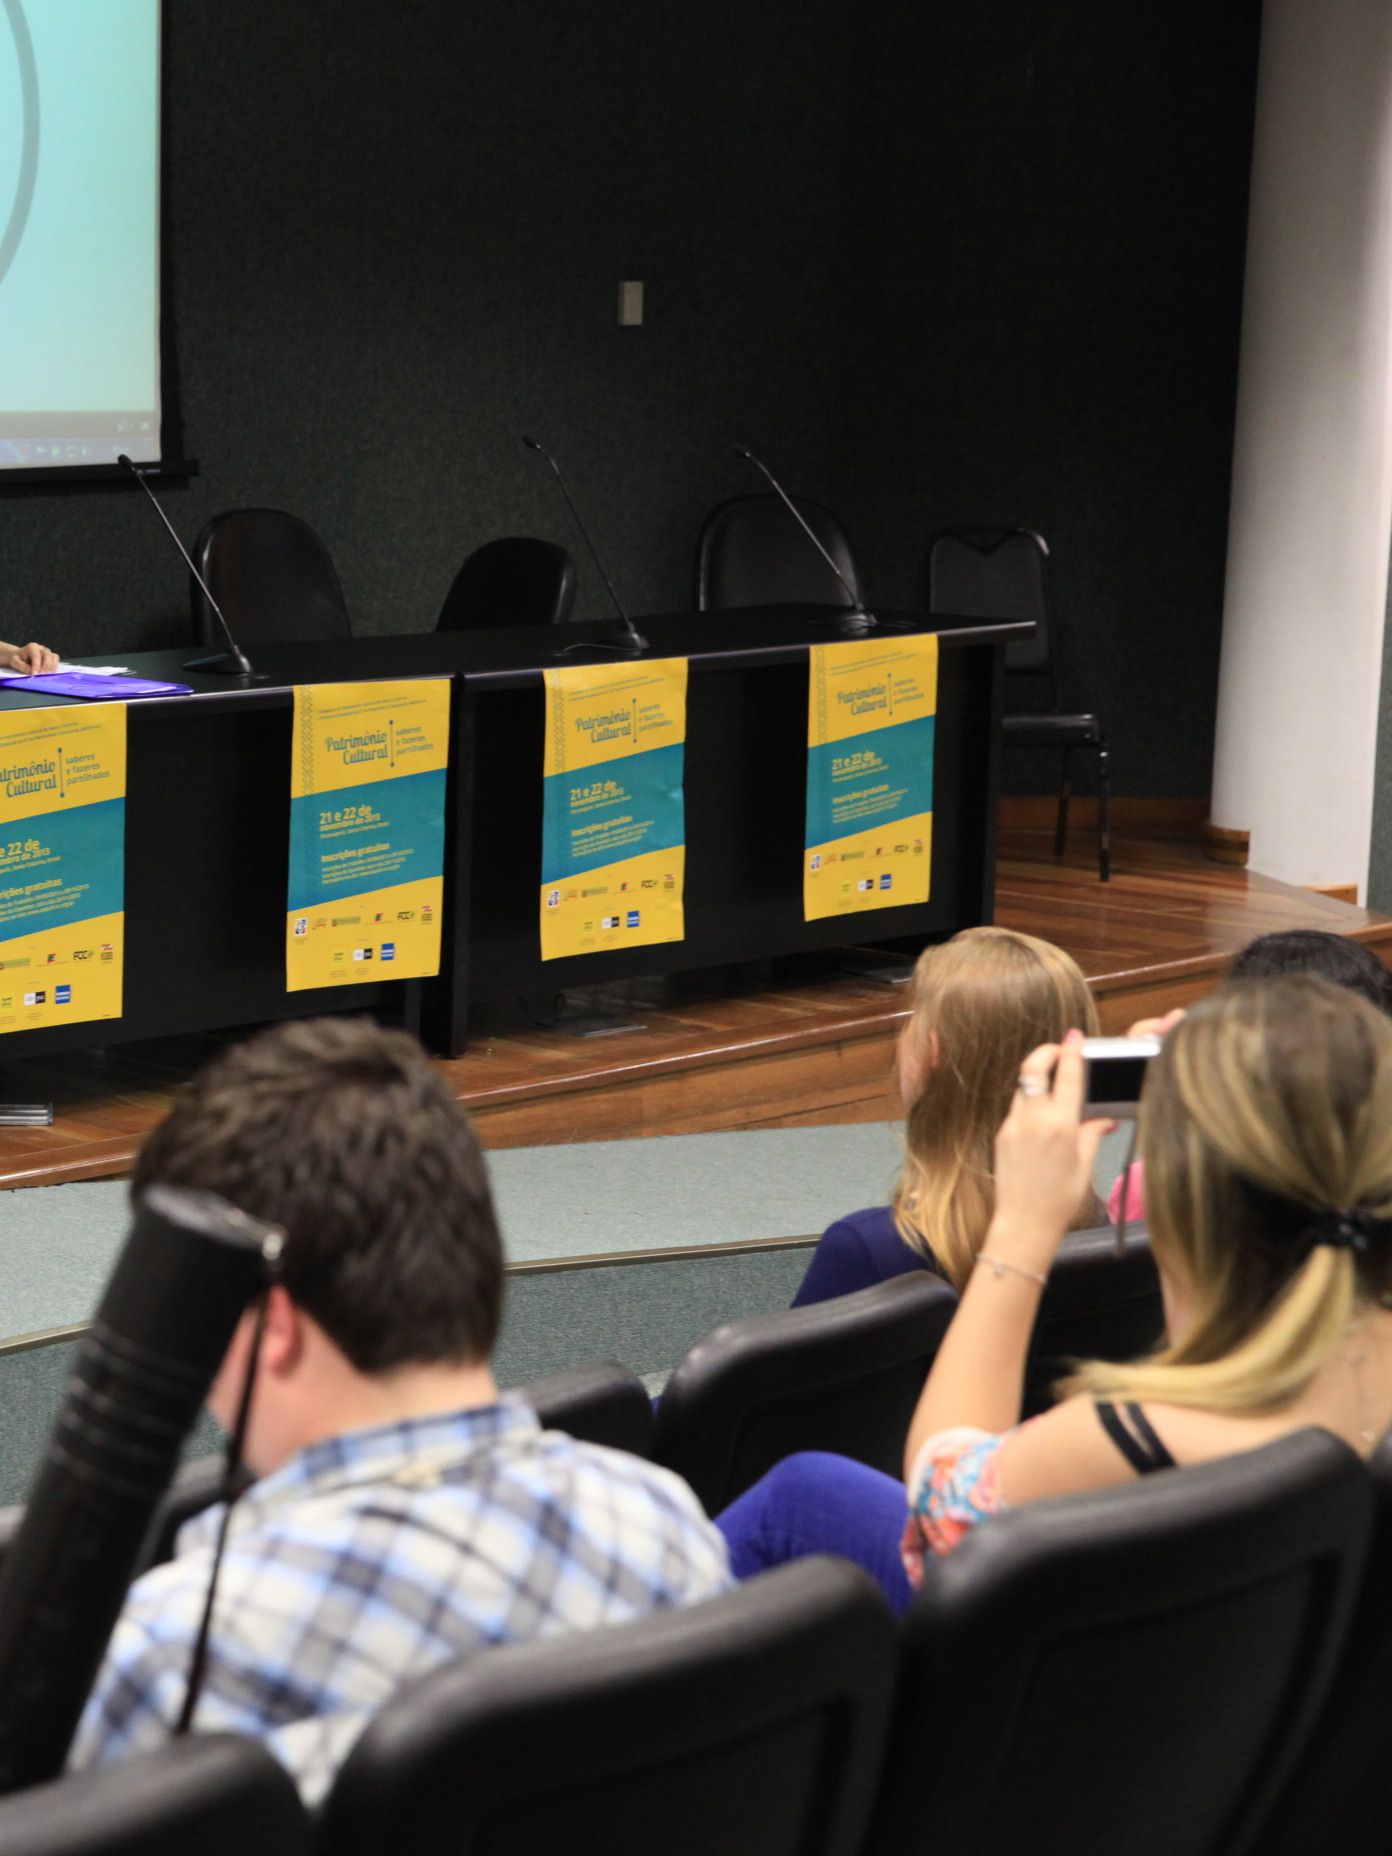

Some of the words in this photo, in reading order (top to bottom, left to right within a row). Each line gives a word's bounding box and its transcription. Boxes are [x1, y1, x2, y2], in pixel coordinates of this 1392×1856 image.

[591, 722, 631, 743] Cultural
[65, 753, 95, 765] saberes
[343, 745, 388, 765] Cultural
[72, 762, 100, 774] fazeres
[6, 774, 57, 798] Cultural
[66, 770, 110, 787] partilhados
[570, 789, 581, 801] 21
[583, 789, 589, 797] e
[591, 783, 602, 795] 22
[320, 812, 332, 824] 21
[334, 812, 341, 821] e
[343, 807, 356, 820] 22
[358, 804, 371, 816] de
[7, 842, 22, 856] 22
[24, 839, 40, 851] de
[73, 950, 88, 961] FCC
